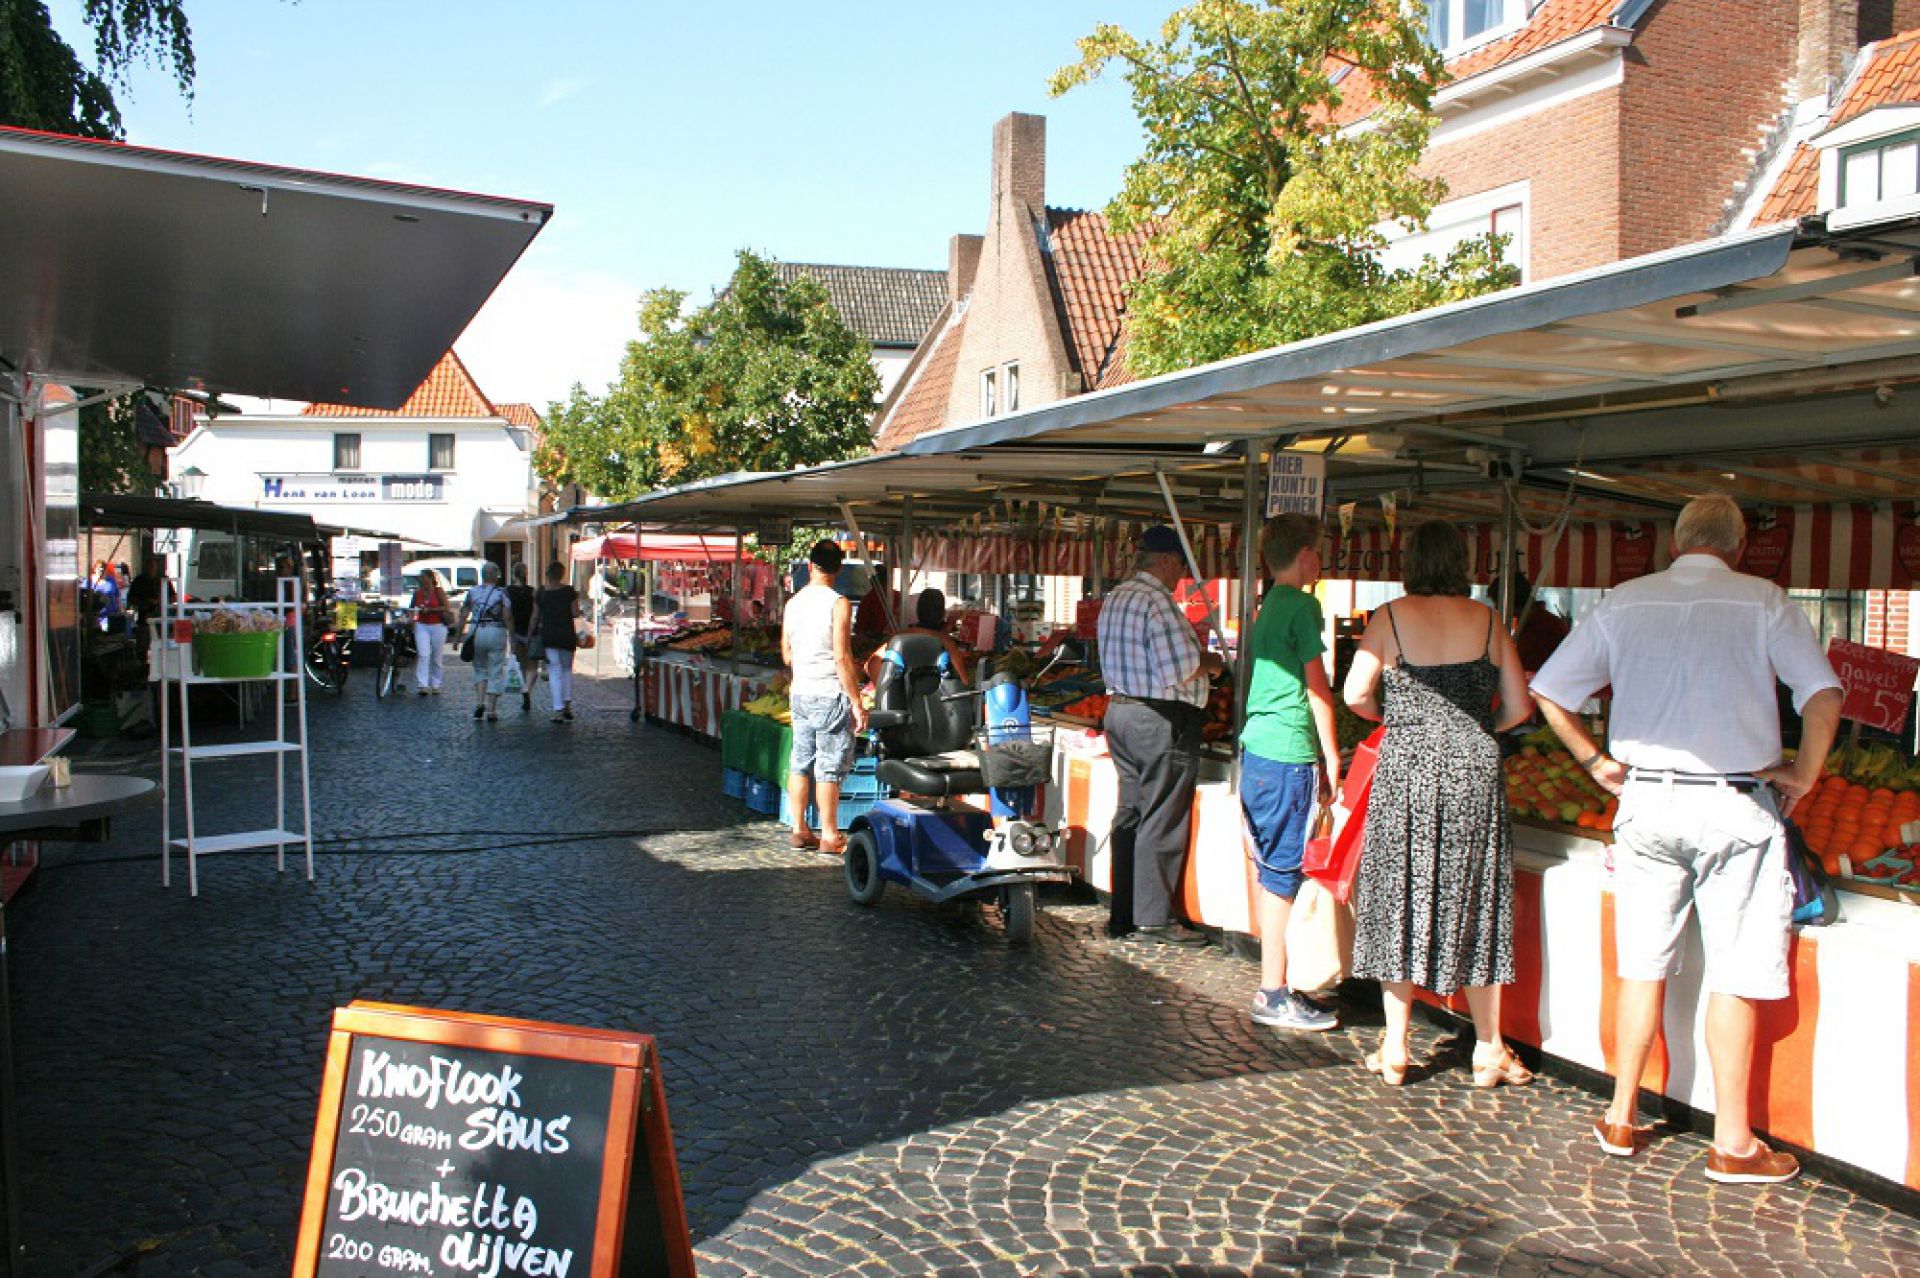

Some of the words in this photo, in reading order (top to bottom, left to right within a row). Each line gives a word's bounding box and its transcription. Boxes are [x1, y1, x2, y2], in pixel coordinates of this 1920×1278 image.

[1273, 454, 1303, 475] HIER
[314, 490, 337, 498] van
[343, 488, 376, 498] Loon
[391, 479, 434, 499] mode
[1271, 475, 1306, 494] KUNT
[1308, 476, 1318, 495] U
[1268, 495, 1317, 514] PINNEN
[349, 1103, 400, 1137] 250
[400, 1123, 451, 1149] GRAM
[458, 1106, 571, 1154] SAUS
[327, 1233, 373, 1261] 200
